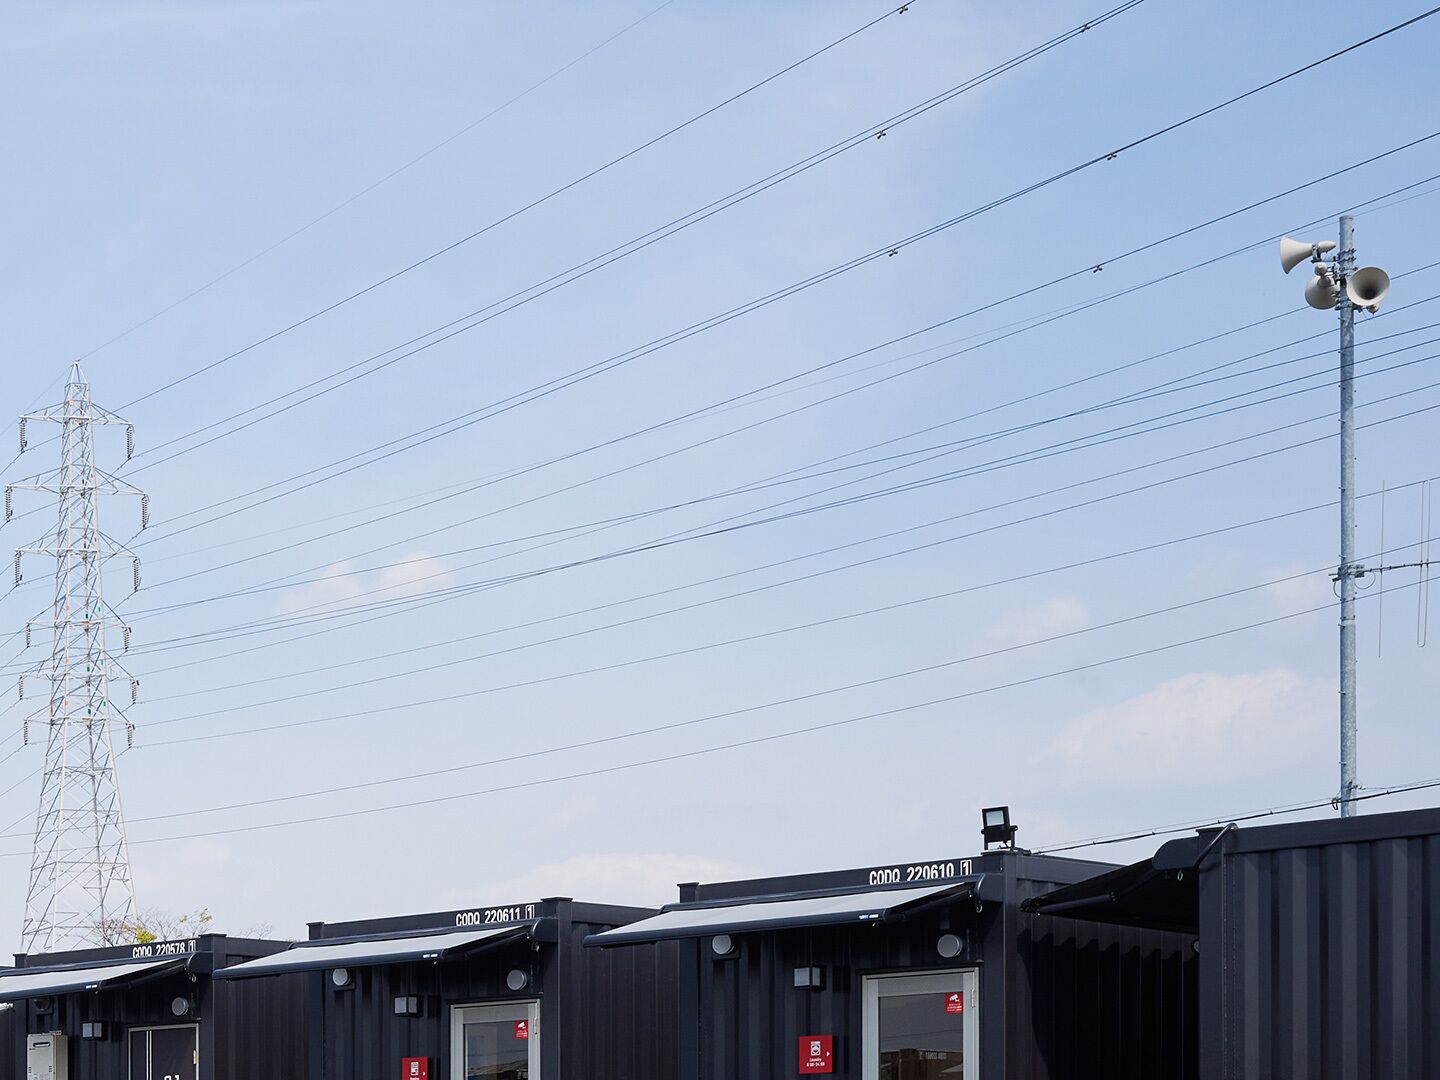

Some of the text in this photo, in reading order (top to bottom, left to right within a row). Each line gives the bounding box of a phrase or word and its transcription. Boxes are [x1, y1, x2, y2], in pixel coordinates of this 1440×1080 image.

[869, 868, 901, 885] CODQ
[906, 862, 954, 882] 220610
[456, 911, 481, 927] CODQ
[484, 907, 520, 924] 220611
[156, 942, 186, 956] 220578
